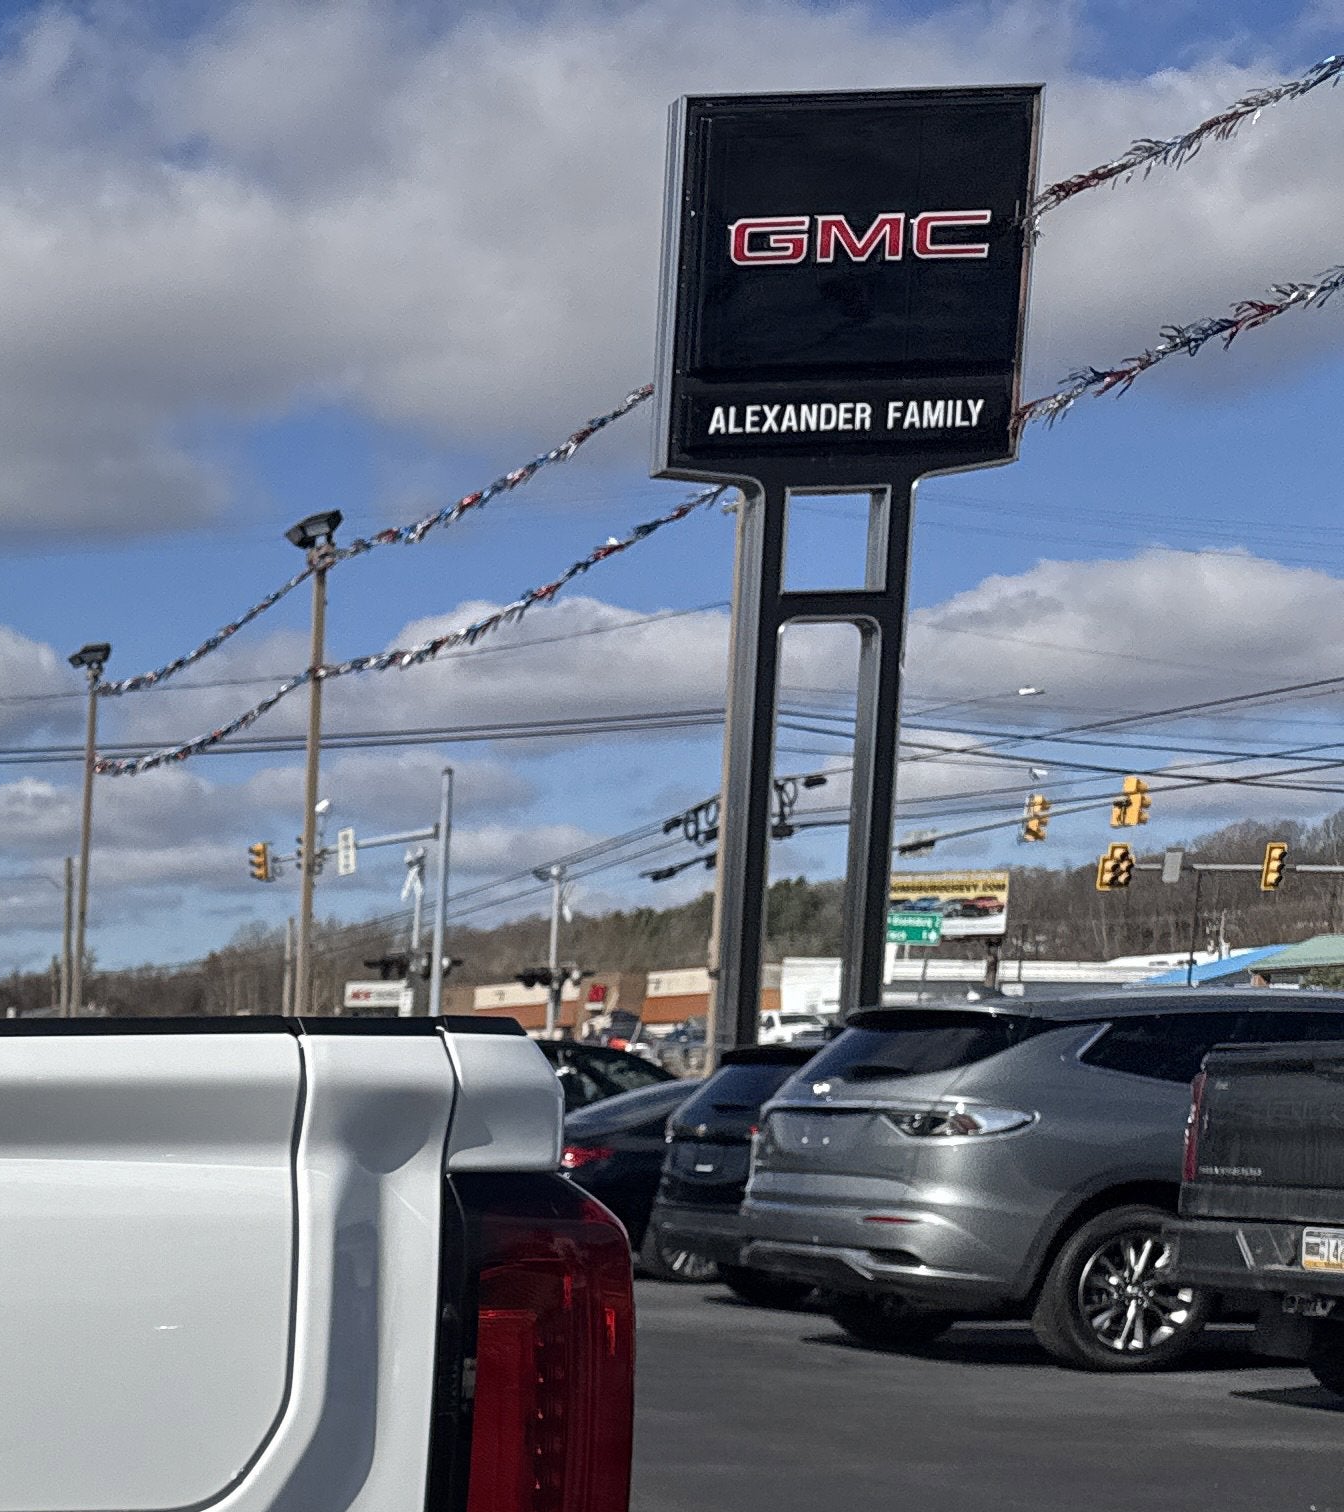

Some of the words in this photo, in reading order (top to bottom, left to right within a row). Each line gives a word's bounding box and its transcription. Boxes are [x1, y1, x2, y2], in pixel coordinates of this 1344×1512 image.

[728, 209, 991, 266] GMC
[708, 403, 872, 435] ALEXANDER
[886, 398, 985, 430] FAMILY
